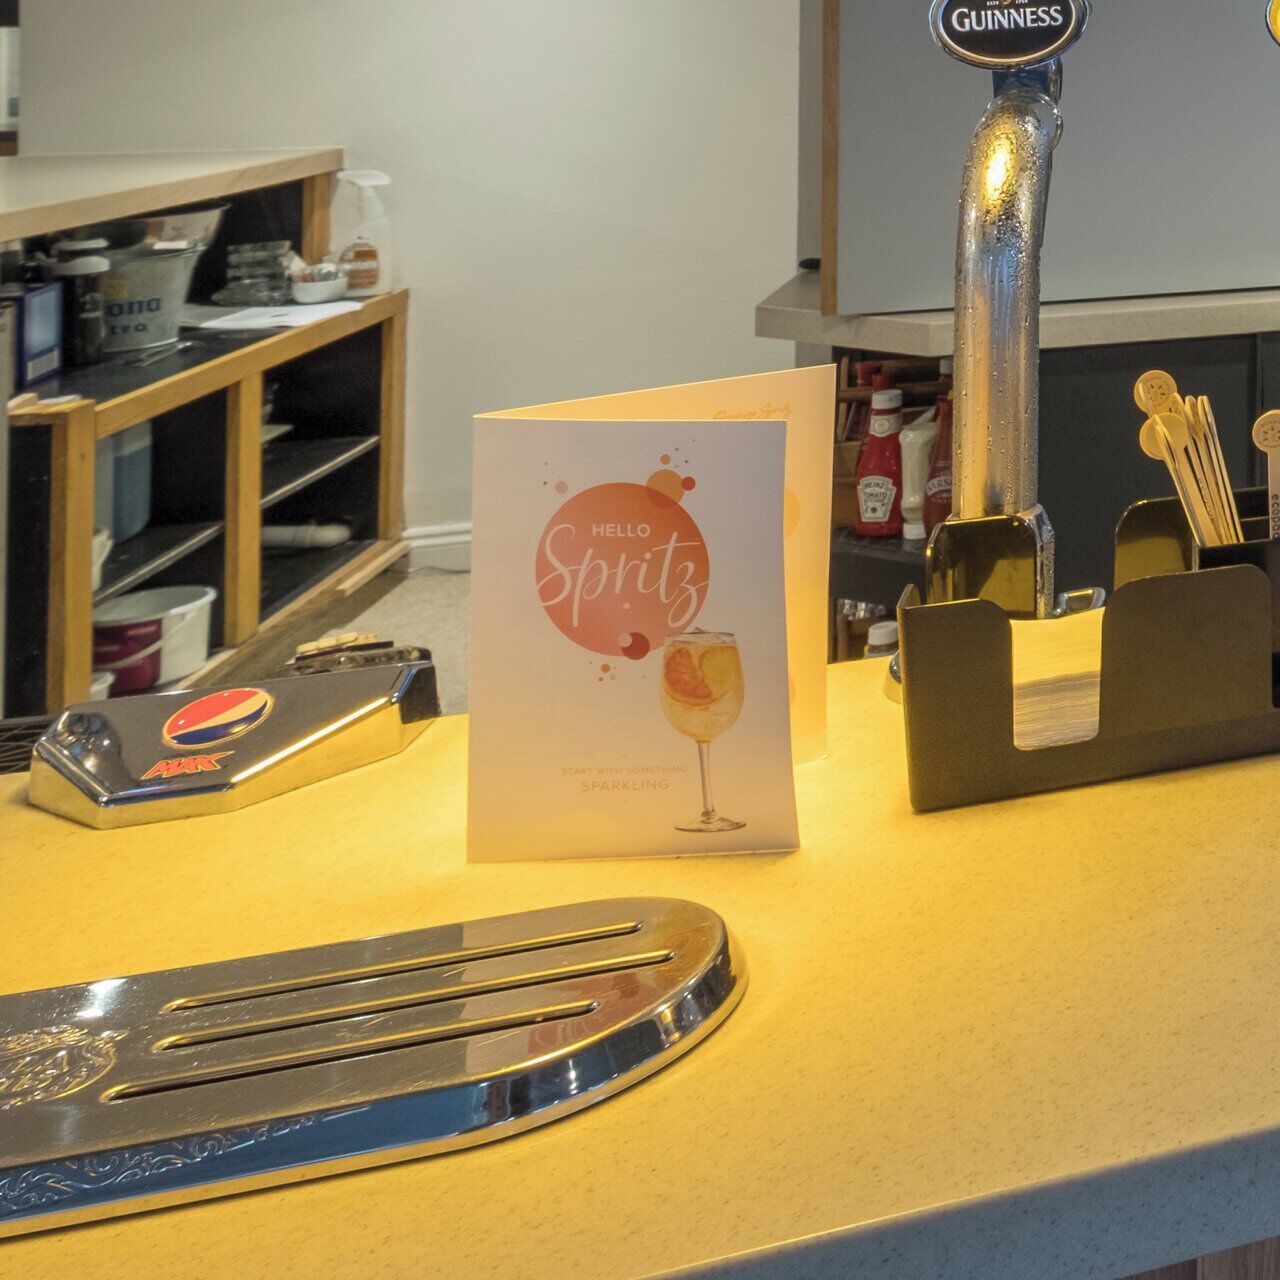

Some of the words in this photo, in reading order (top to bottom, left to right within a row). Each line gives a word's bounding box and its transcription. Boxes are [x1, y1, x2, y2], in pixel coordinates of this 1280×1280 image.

[951, 6, 1064, 32] GUINNESS
[106, 298, 161, 317] ona
[863, 481, 886, 490] HEINZ
[592, 523, 651, 538] HELLO
[534, 523, 711, 628] Spritz
[140, 750, 236, 780] MAX
[562, 767, 593, 776] START
[598, 767, 622, 775] WITH
[626, 765, 689, 775] SOMETHING
[582, 779, 670, 792] SPARKLING
